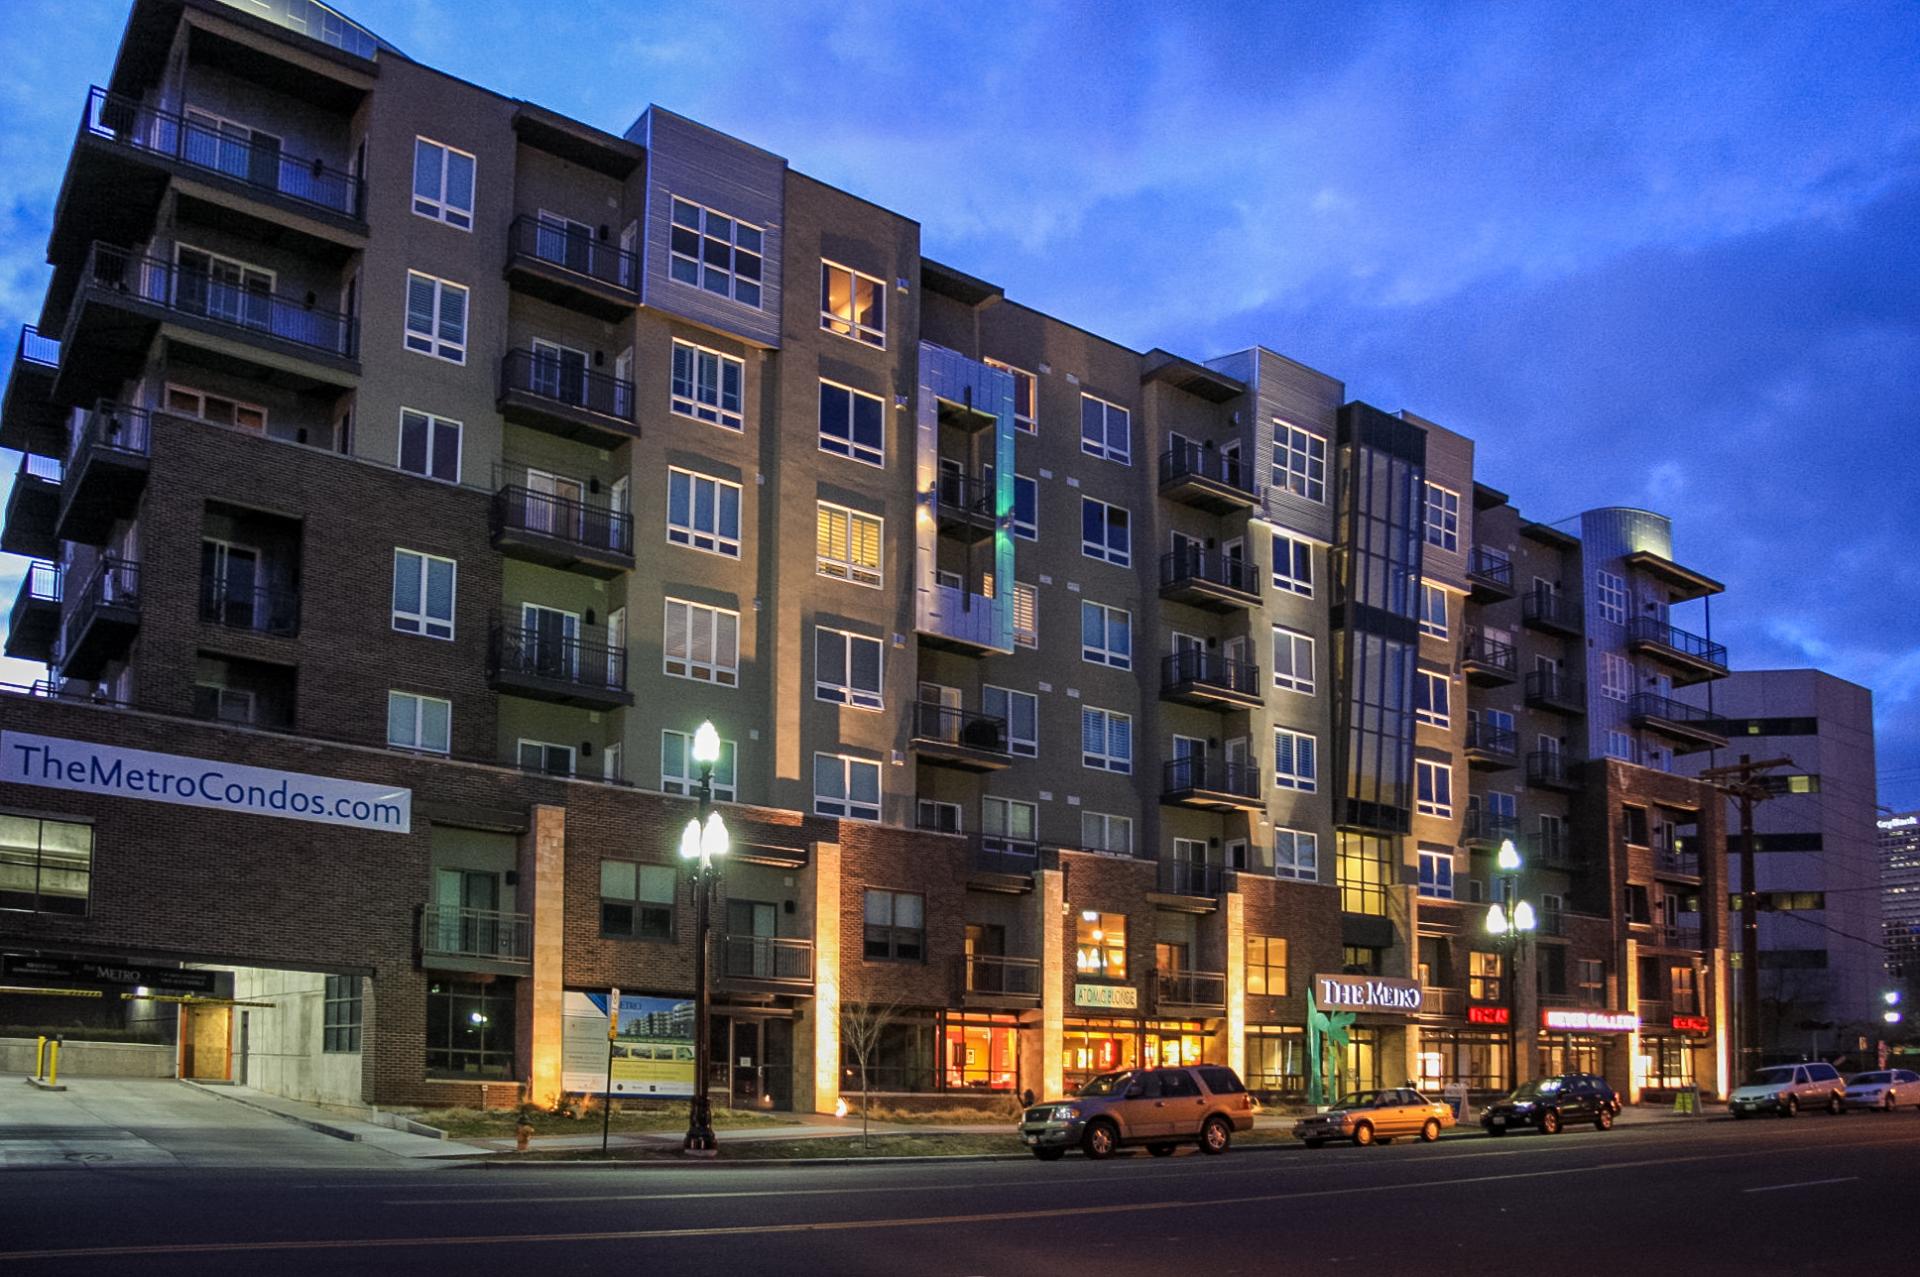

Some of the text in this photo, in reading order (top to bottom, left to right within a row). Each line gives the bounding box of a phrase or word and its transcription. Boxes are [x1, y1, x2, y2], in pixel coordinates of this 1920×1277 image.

[13, 743, 402, 826] TheMetroCondos.com
[96, 965, 141, 981] METRO
[1320, 979, 1421, 1008] THE METRO
